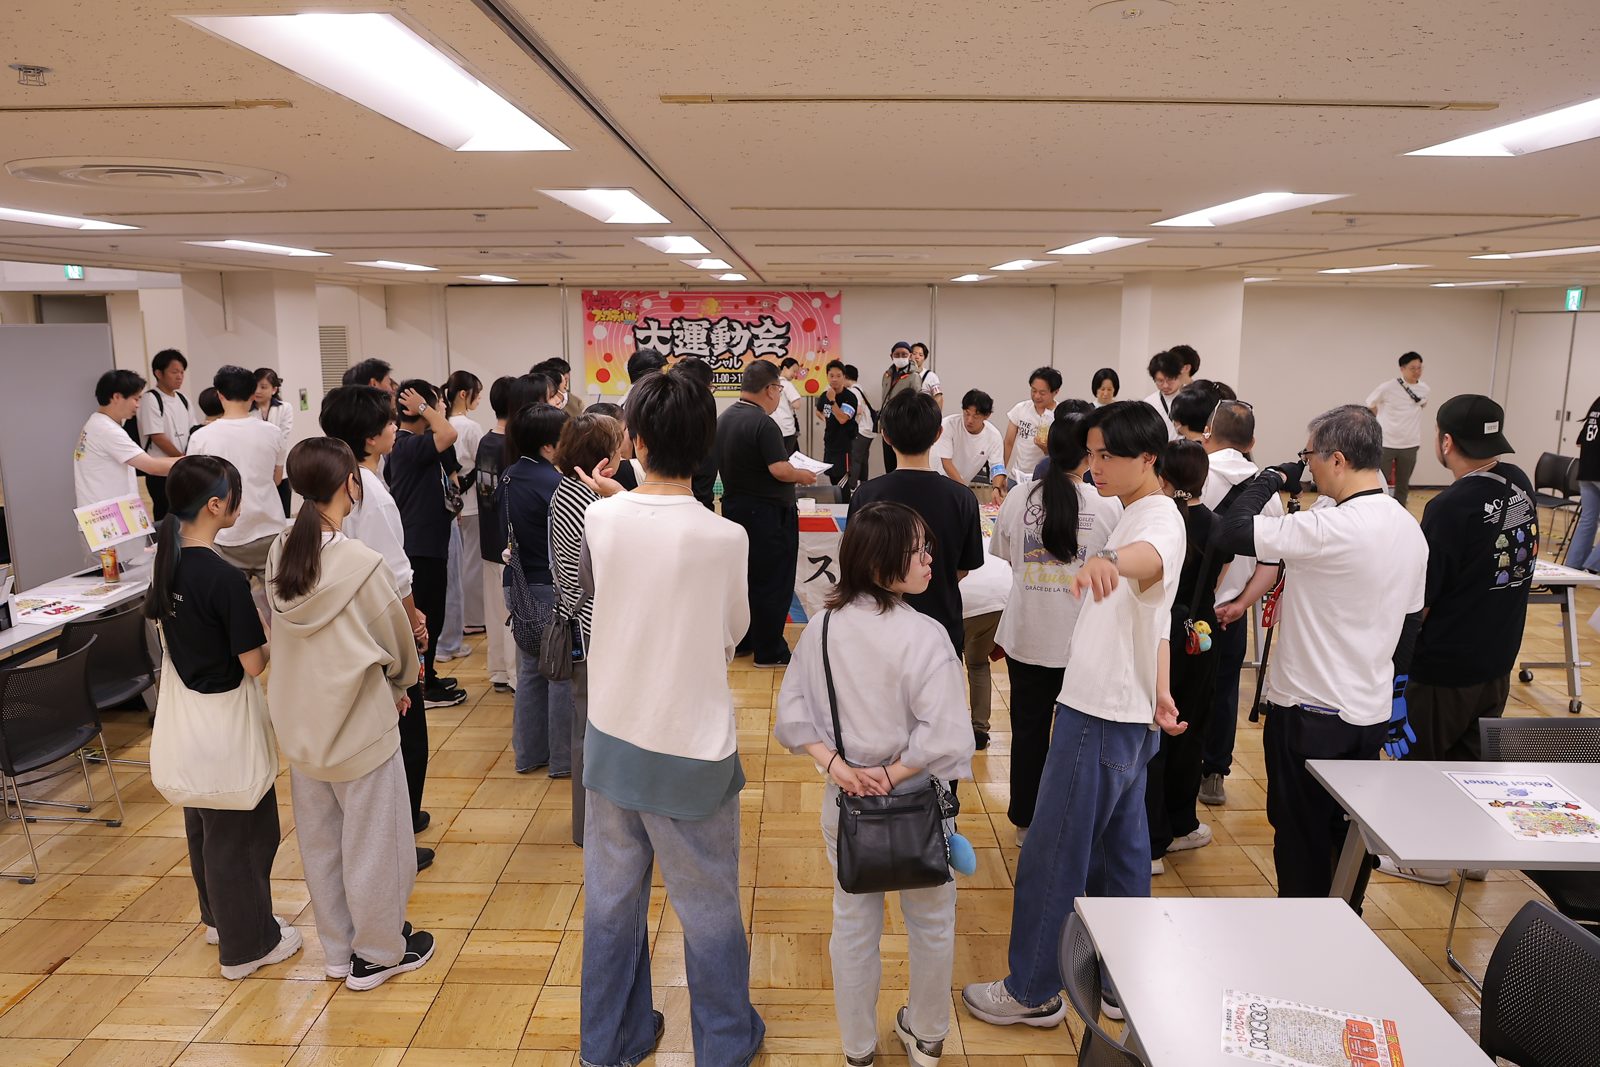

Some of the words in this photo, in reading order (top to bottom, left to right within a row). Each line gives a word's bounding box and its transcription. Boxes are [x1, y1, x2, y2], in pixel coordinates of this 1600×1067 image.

[634, 316, 790, 357] 大運動会
[692, 356, 742, 369] ペシャル
[1019, 420, 1032, 430] THE
[803, 555, 837, 584] ス
[1463, 778, 1507, 788] Planet
[1249, 1003, 1270, 1050] KNOCK
